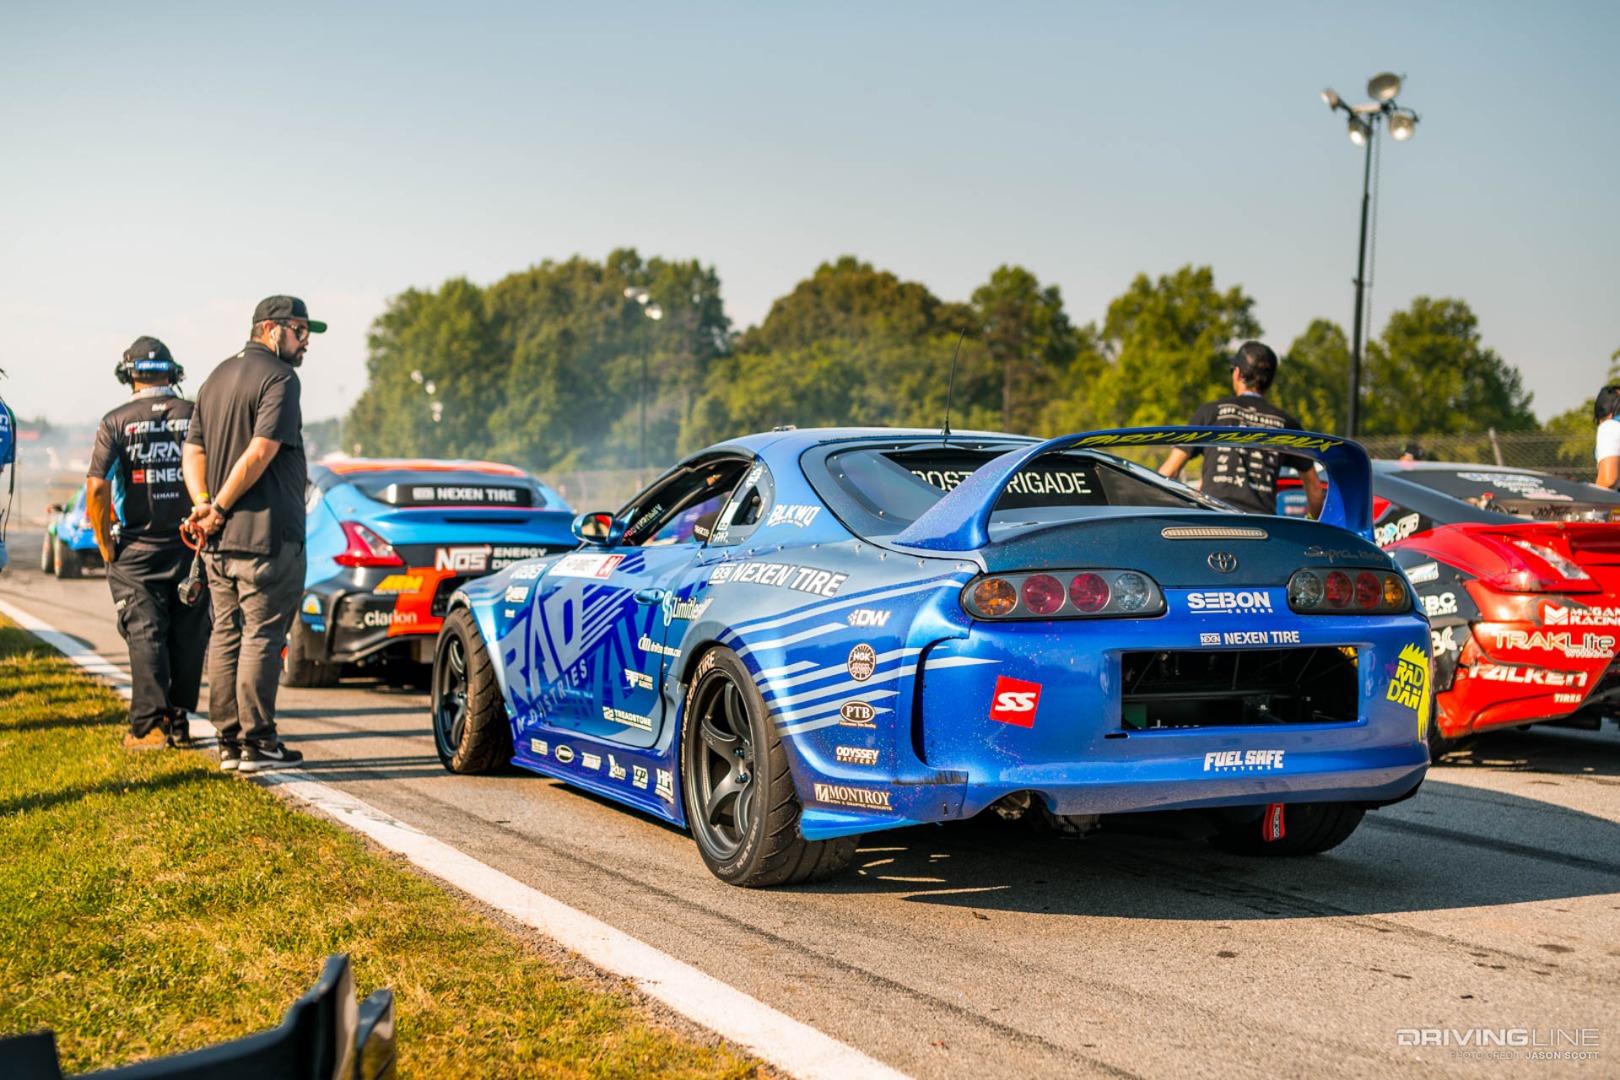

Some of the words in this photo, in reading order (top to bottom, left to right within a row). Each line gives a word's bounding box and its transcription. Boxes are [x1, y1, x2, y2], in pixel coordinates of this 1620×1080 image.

[1003, 472, 1092, 494] RIGADE
[437, 487, 484, 501] NEXEN
[485, 488, 517, 502] TIRE
[435, 546, 492, 572] NOS
[493, 547, 547, 558] ENERGY
[729, 563, 796, 588] NEXEN
[790, 566, 846, 597] TIRE
[1187, 592, 1271, 608] SEBON
[364, 610, 417, 626] clarion
[856, 609, 891, 626] DW
[1570, 616, 1620, 626] RACIN
[1224, 632, 1268, 645] NEXEN
[1270, 631, 1300, 643] TIRE
[853, 652, 870, 661] NGK
[995, 692, 1036, 712] SS
[1554, 693, 1582, 703] TIRES
[846, 705, 870, 719] PTB
[836, 746, 879, 760] ODYSSEY
[836, 754, 877, 765] BATTERY
[1204, 751, 1243, 771] FUEL
[1244, 750, 1285, 768] SAFE
[829, 785, 890, 806] MONTROY
